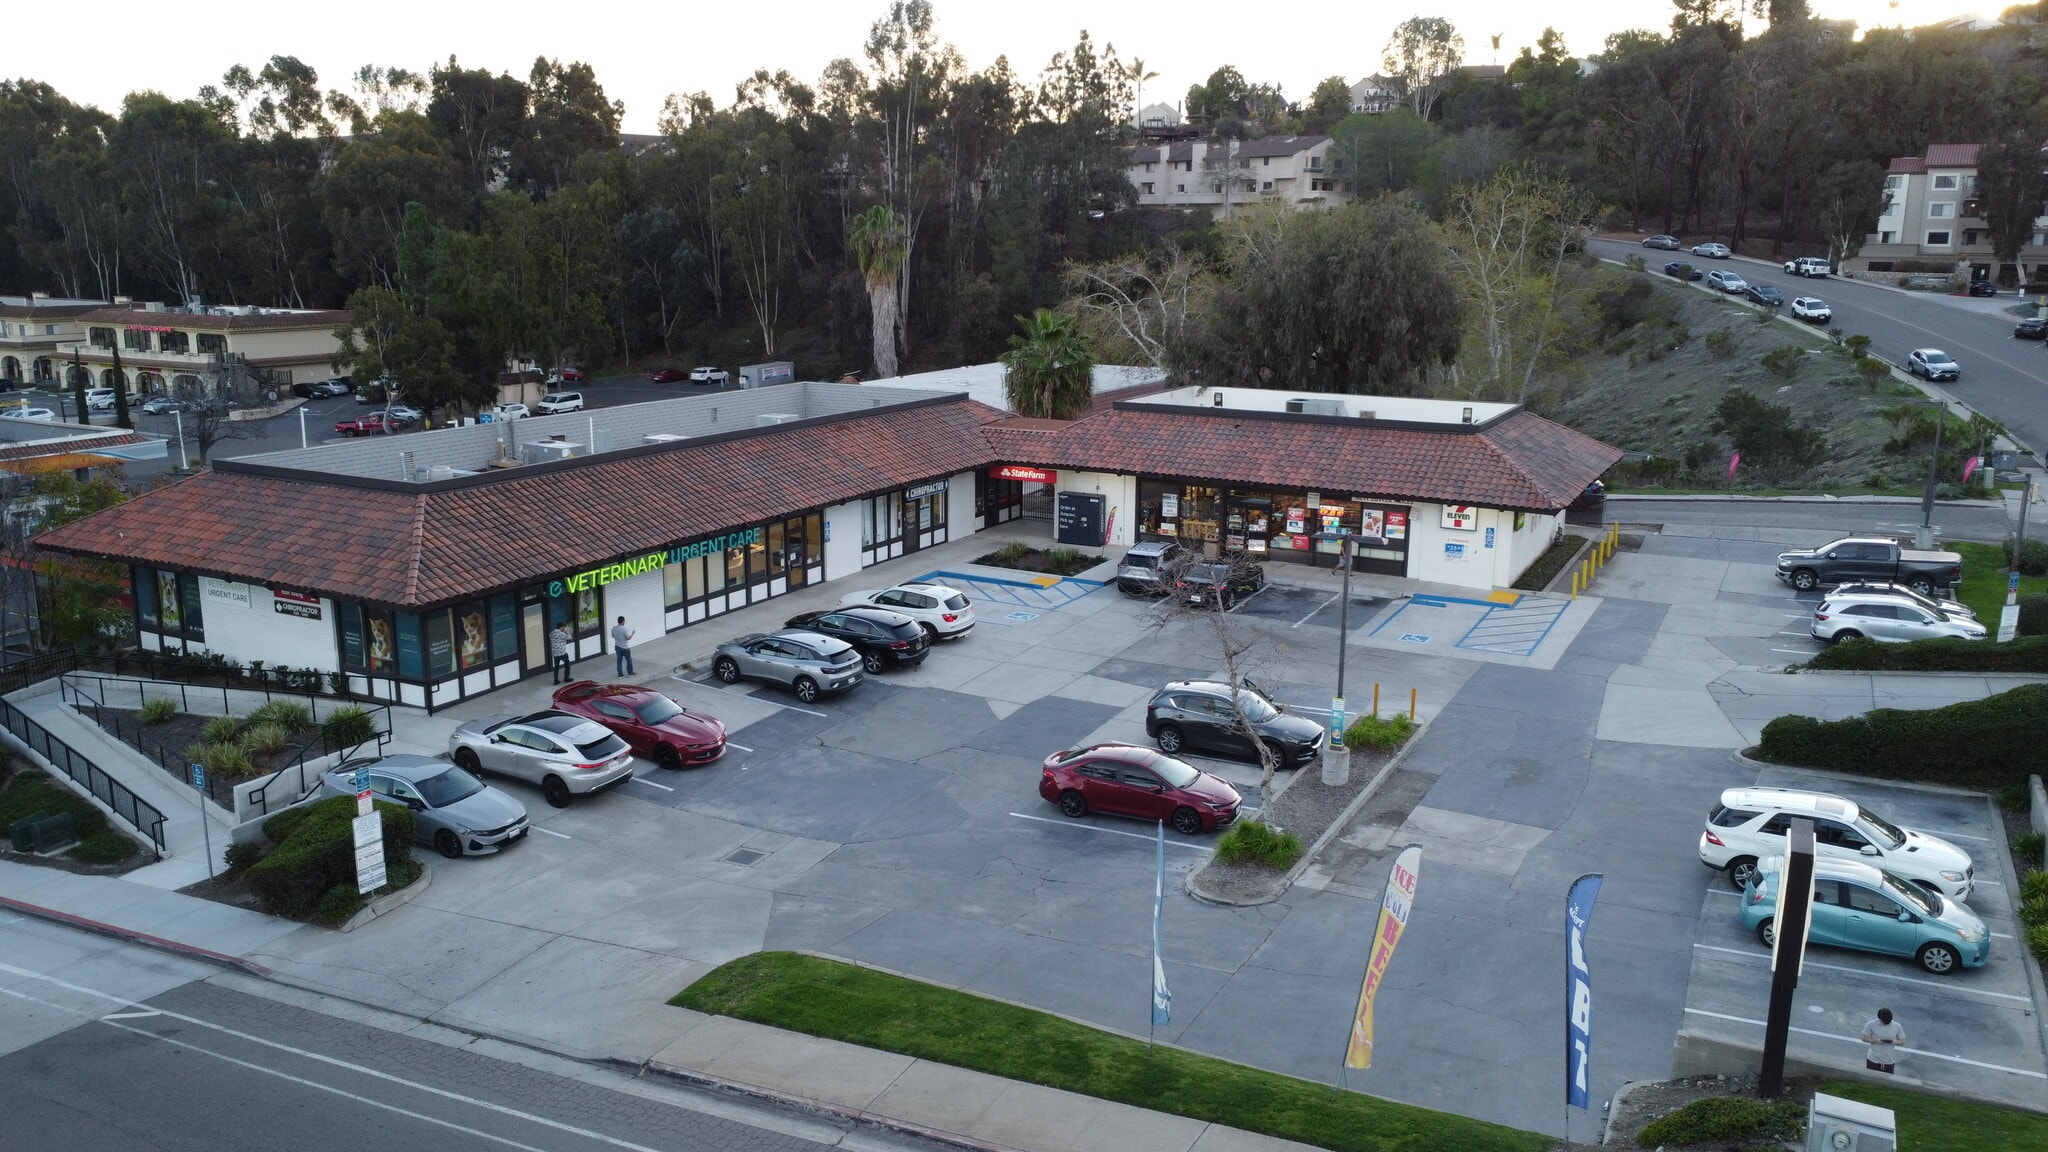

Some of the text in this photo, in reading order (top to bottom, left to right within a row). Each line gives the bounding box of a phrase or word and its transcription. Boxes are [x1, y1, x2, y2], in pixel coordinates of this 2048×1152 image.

[1011, 468, 1046, 480] State Farm
[910, 481, 944, 498] CHIROPRACTOR
[566, 527, 761, 594] VETERINARY URGENT CARE
[207, 589, 232, 600] URGENT
[232, 593, 248, 603] CARE
[282, 603, 318, 615] CHIROPRACTOR
[1394, 863, 1416, 895] ICE
